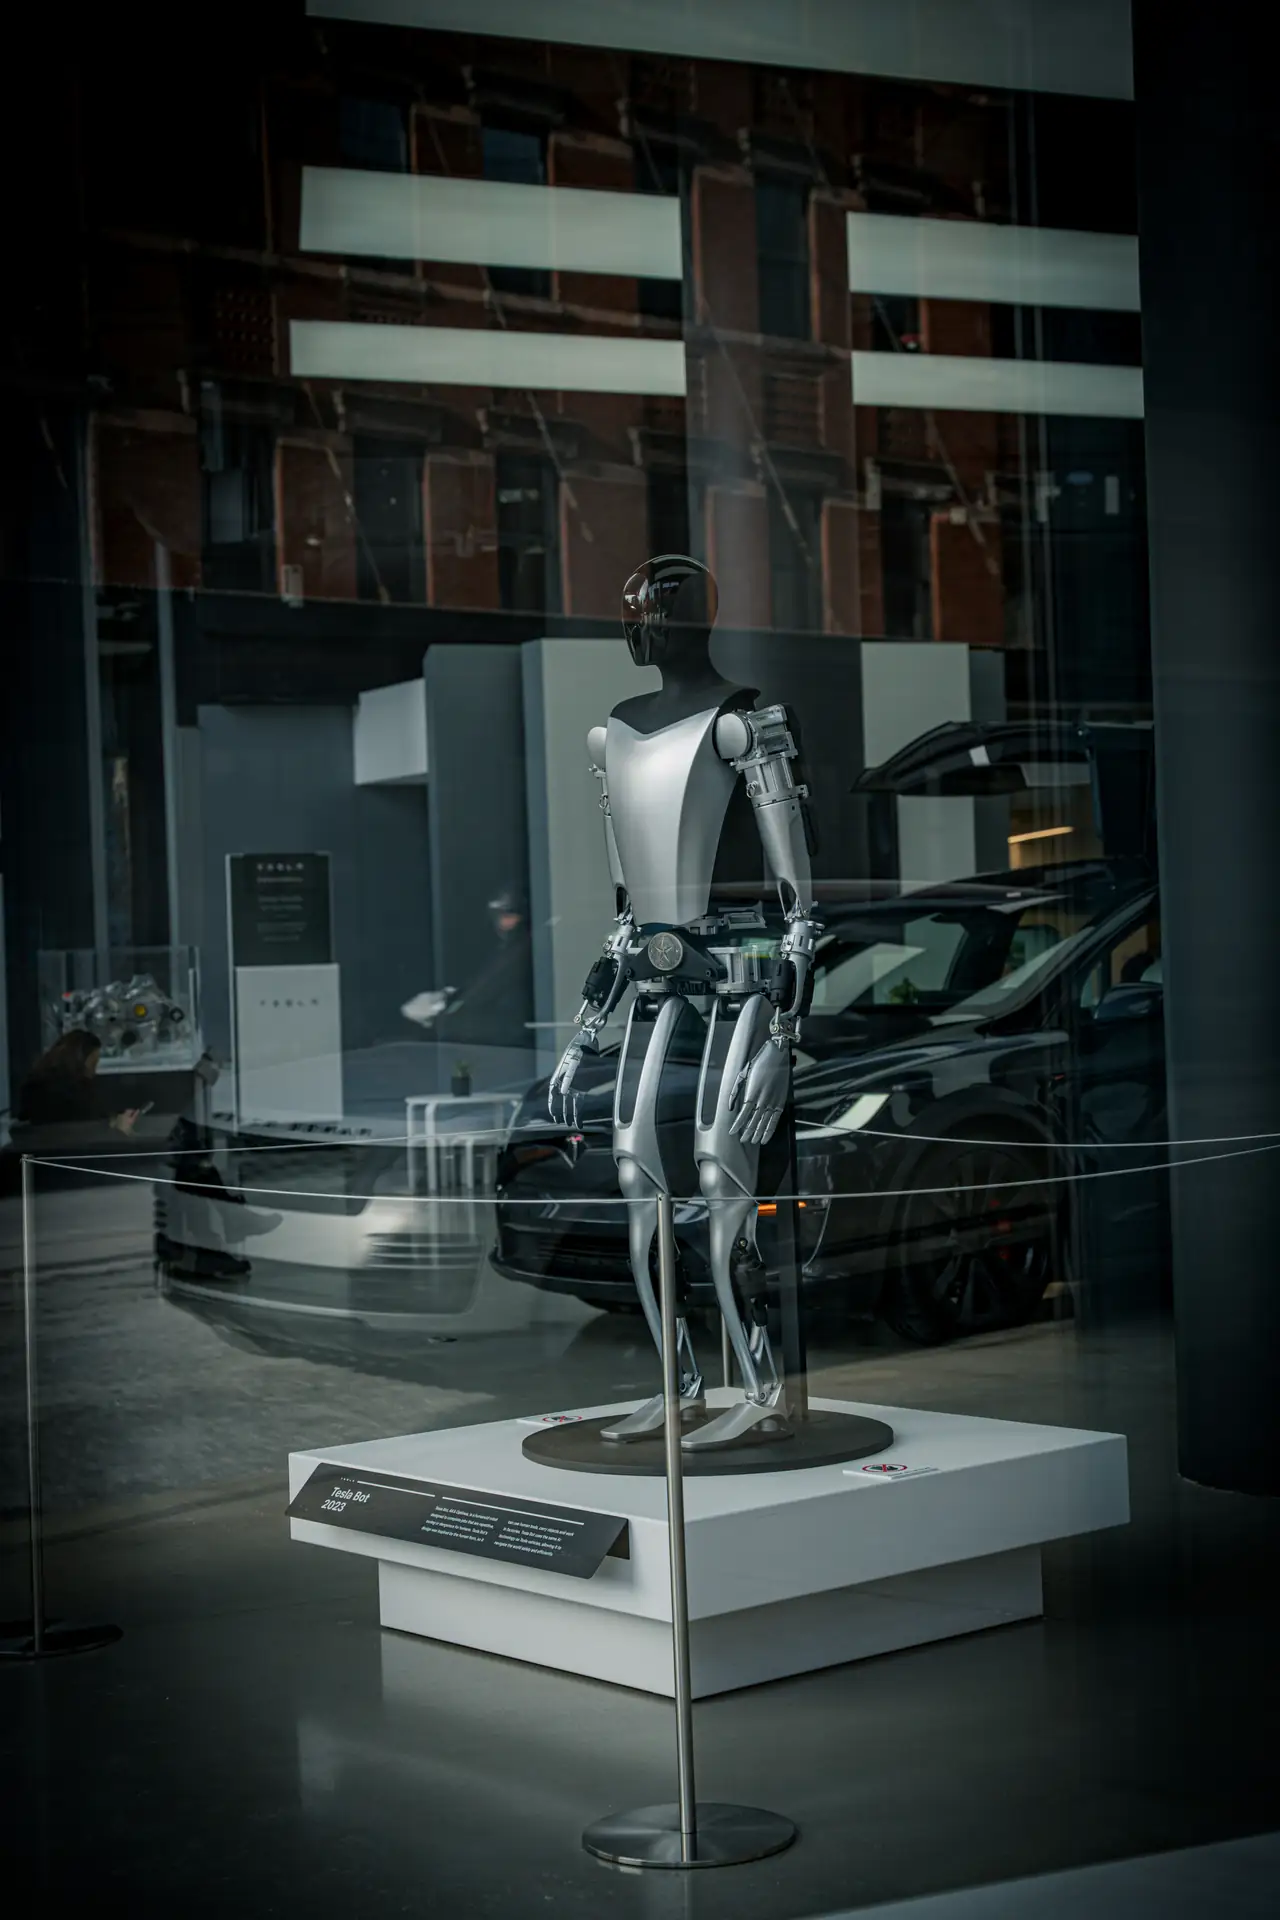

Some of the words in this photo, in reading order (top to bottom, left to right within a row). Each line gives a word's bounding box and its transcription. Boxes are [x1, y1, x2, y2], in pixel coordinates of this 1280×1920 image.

[331, 1487, 353, 1500] Tesla
[353, 1491, 370, 1503] Bot
[321, 1499, 346, 1512] 2023
